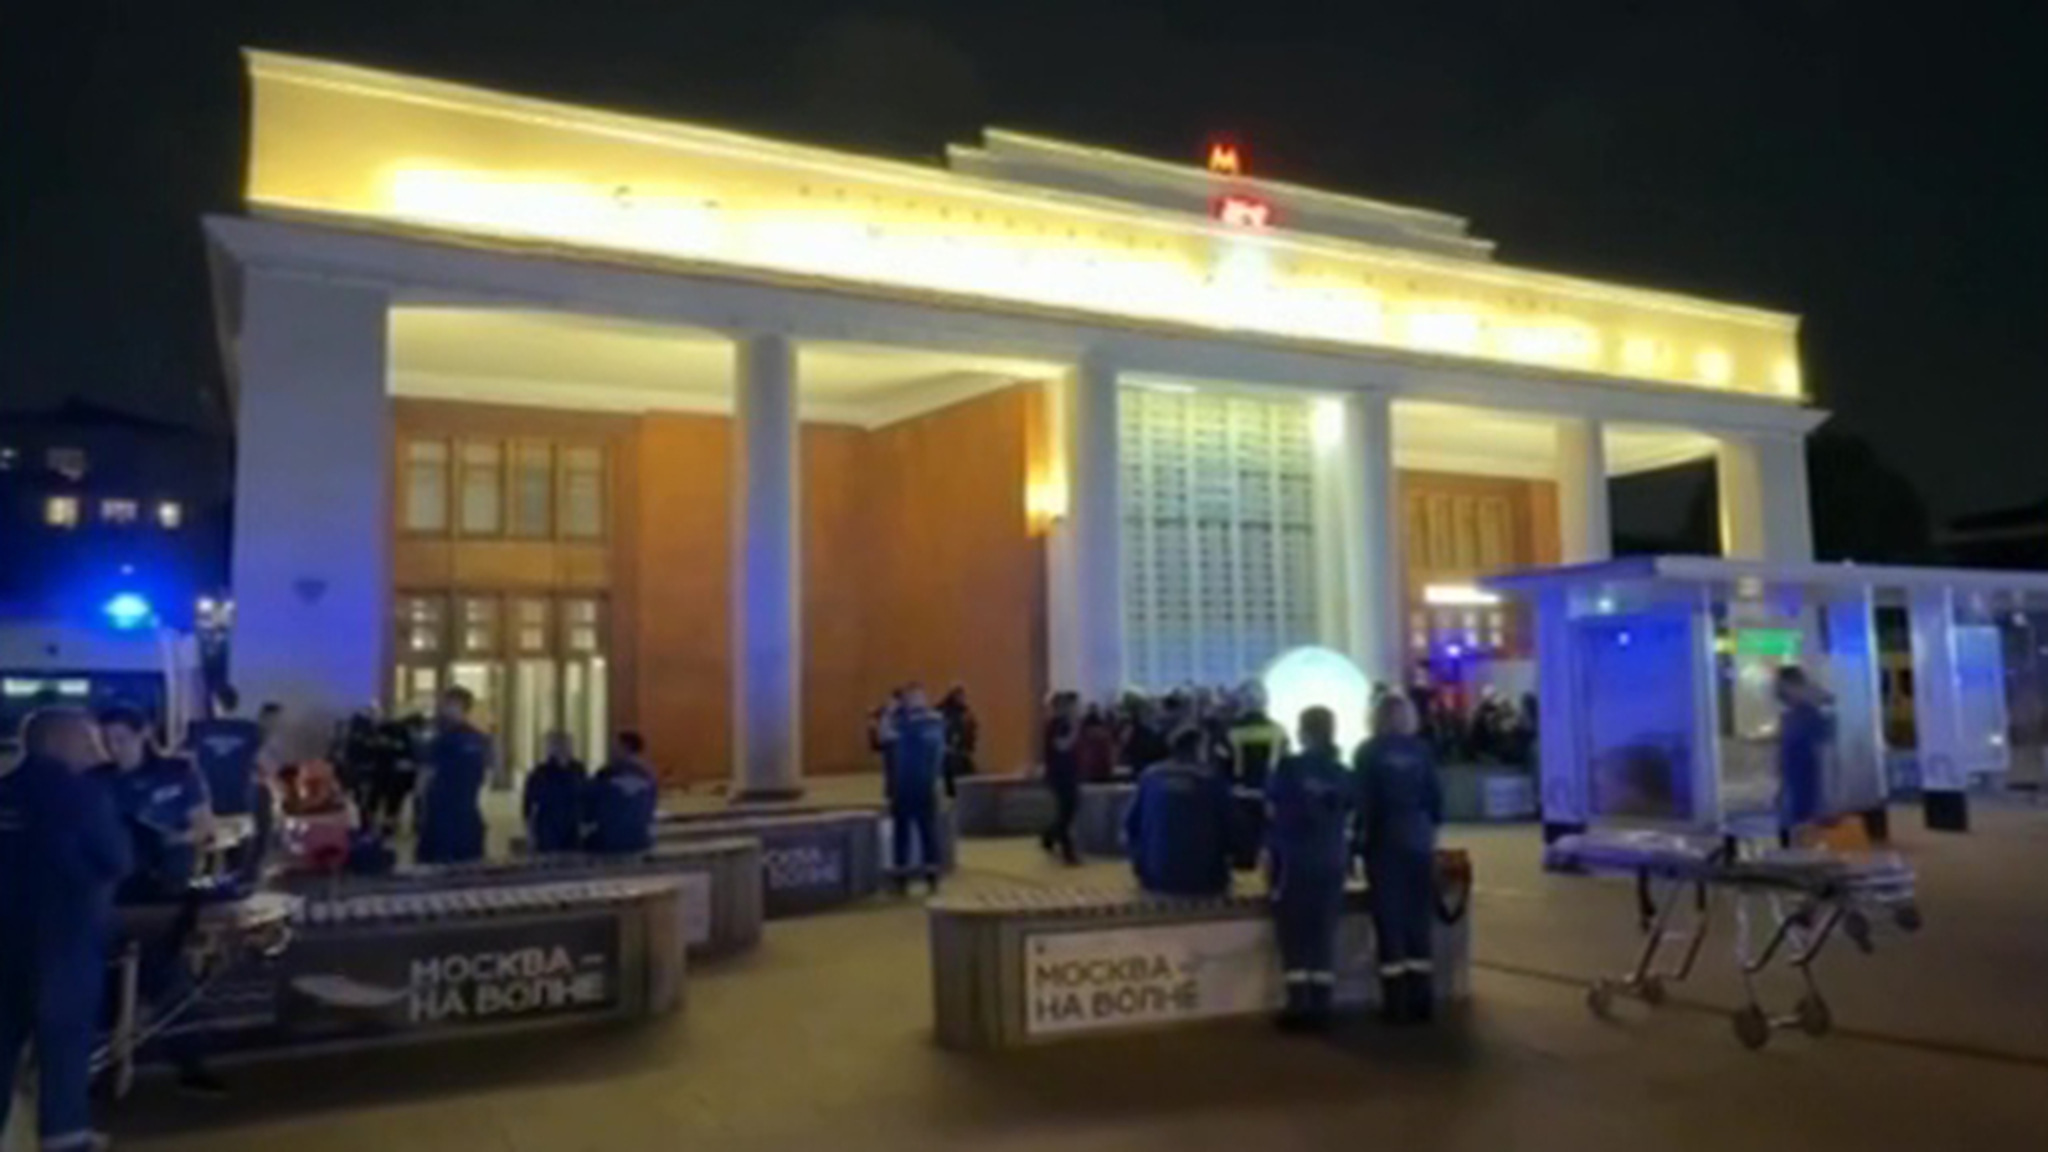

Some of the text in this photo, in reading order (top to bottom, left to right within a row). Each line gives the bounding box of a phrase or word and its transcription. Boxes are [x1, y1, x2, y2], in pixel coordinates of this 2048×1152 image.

[410, 946, 573, 987] МОСКВА
[1036, 956, 1171, 988] МОСКВА
[408, 973, 605, 1022] НА ВОЛНЕ
[1036, 981, 1198, 1022] НА ВОЛНЕ
